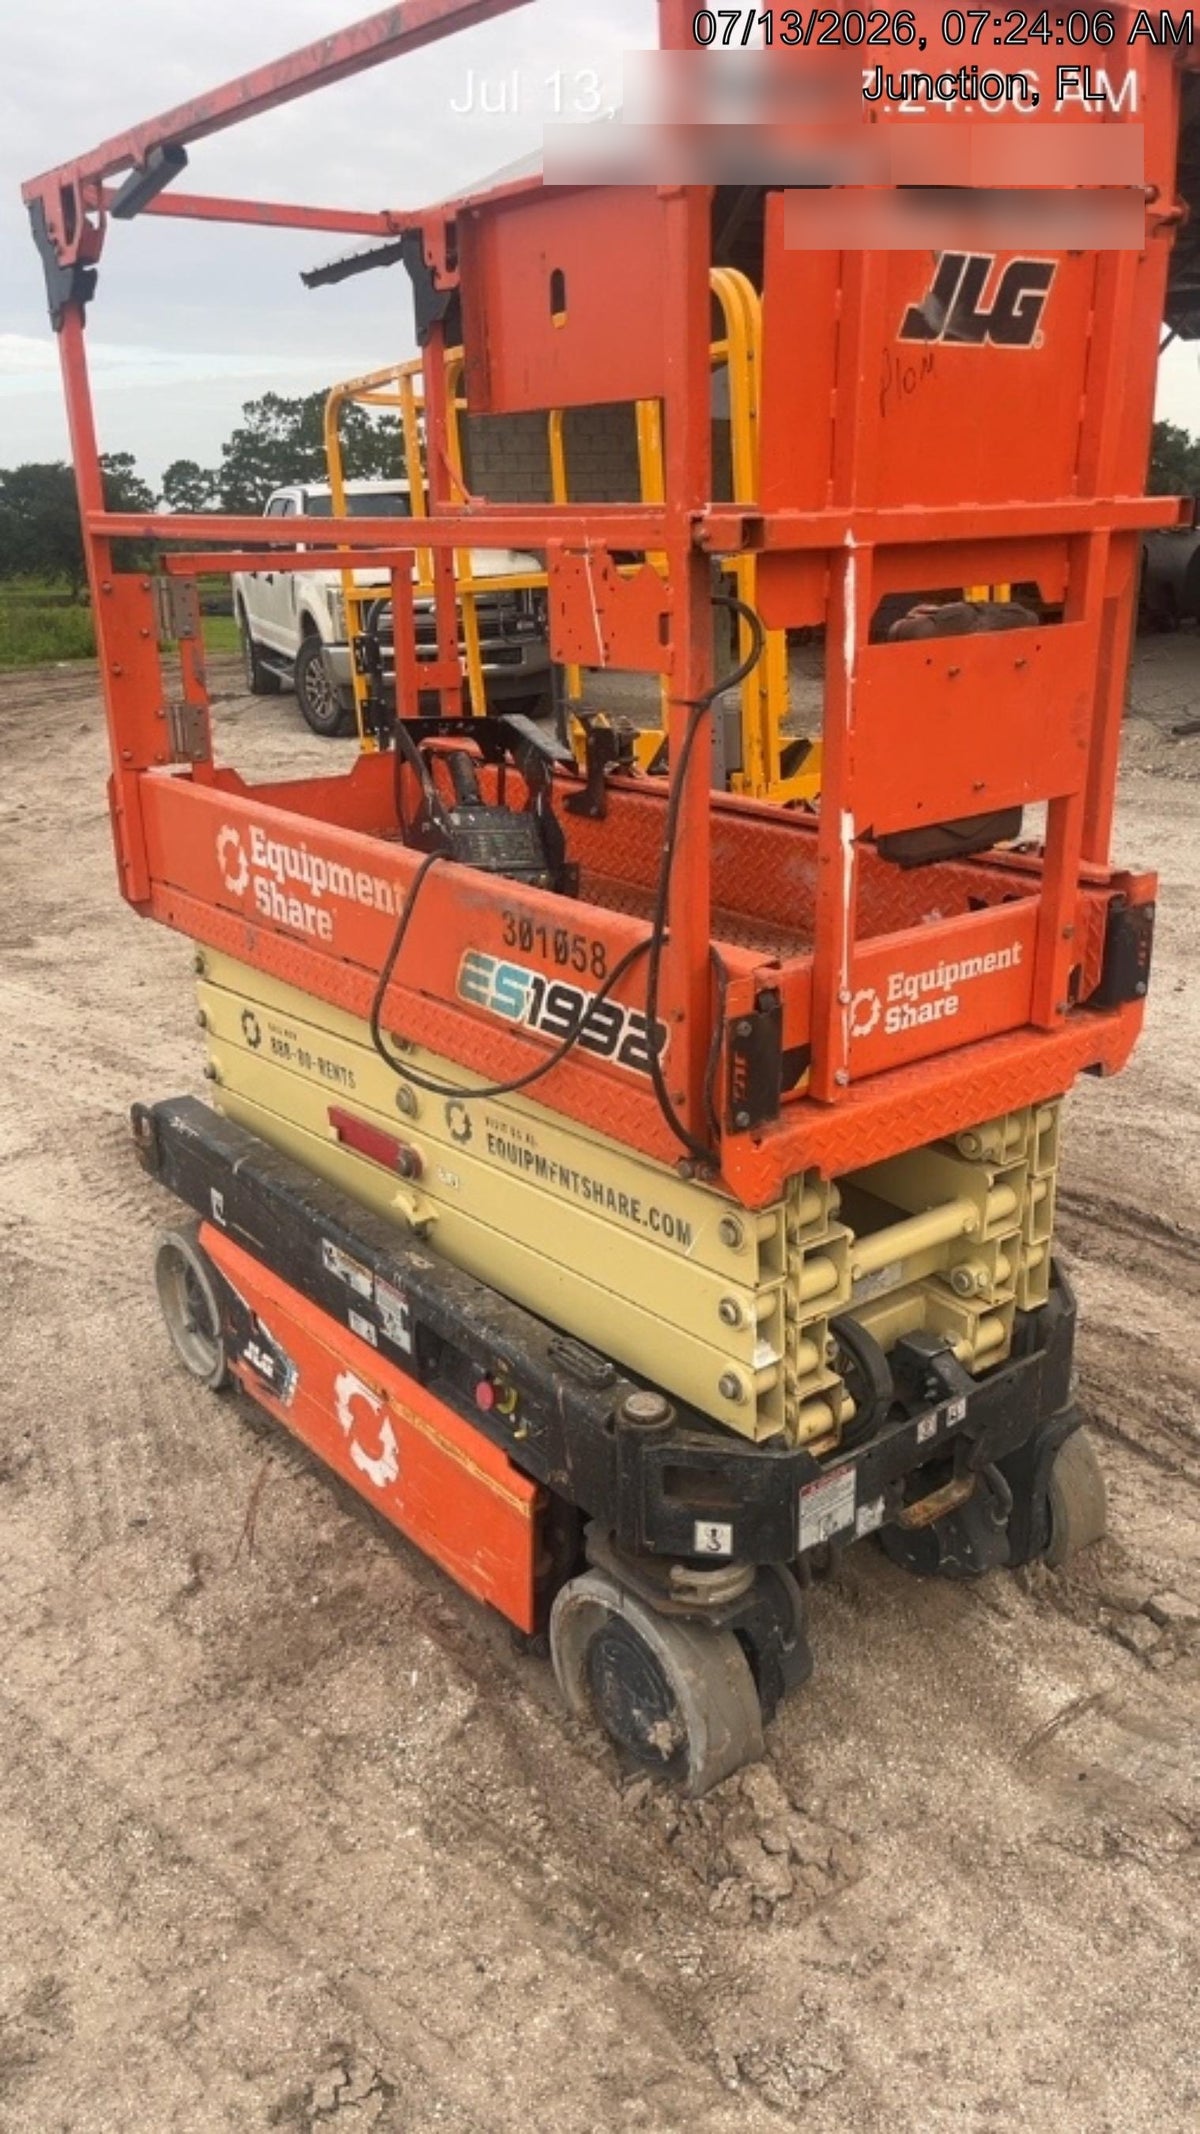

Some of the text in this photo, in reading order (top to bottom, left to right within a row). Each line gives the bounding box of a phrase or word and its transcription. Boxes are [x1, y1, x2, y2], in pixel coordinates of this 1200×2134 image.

[897, 250, 1060, 349] JLG
[249, 824, 406, 917] Equipment
[253, 873, 334, 942] Share
[501, 910, 608, 980] 301058
[886, 940, 1023, 1002] Equipment
[457, 948, 671, 1077] ES1932
[884, 994, 959, 1035] Share
[487, 1132, 693, 1247] EQUIPMENTSHARE.COM
